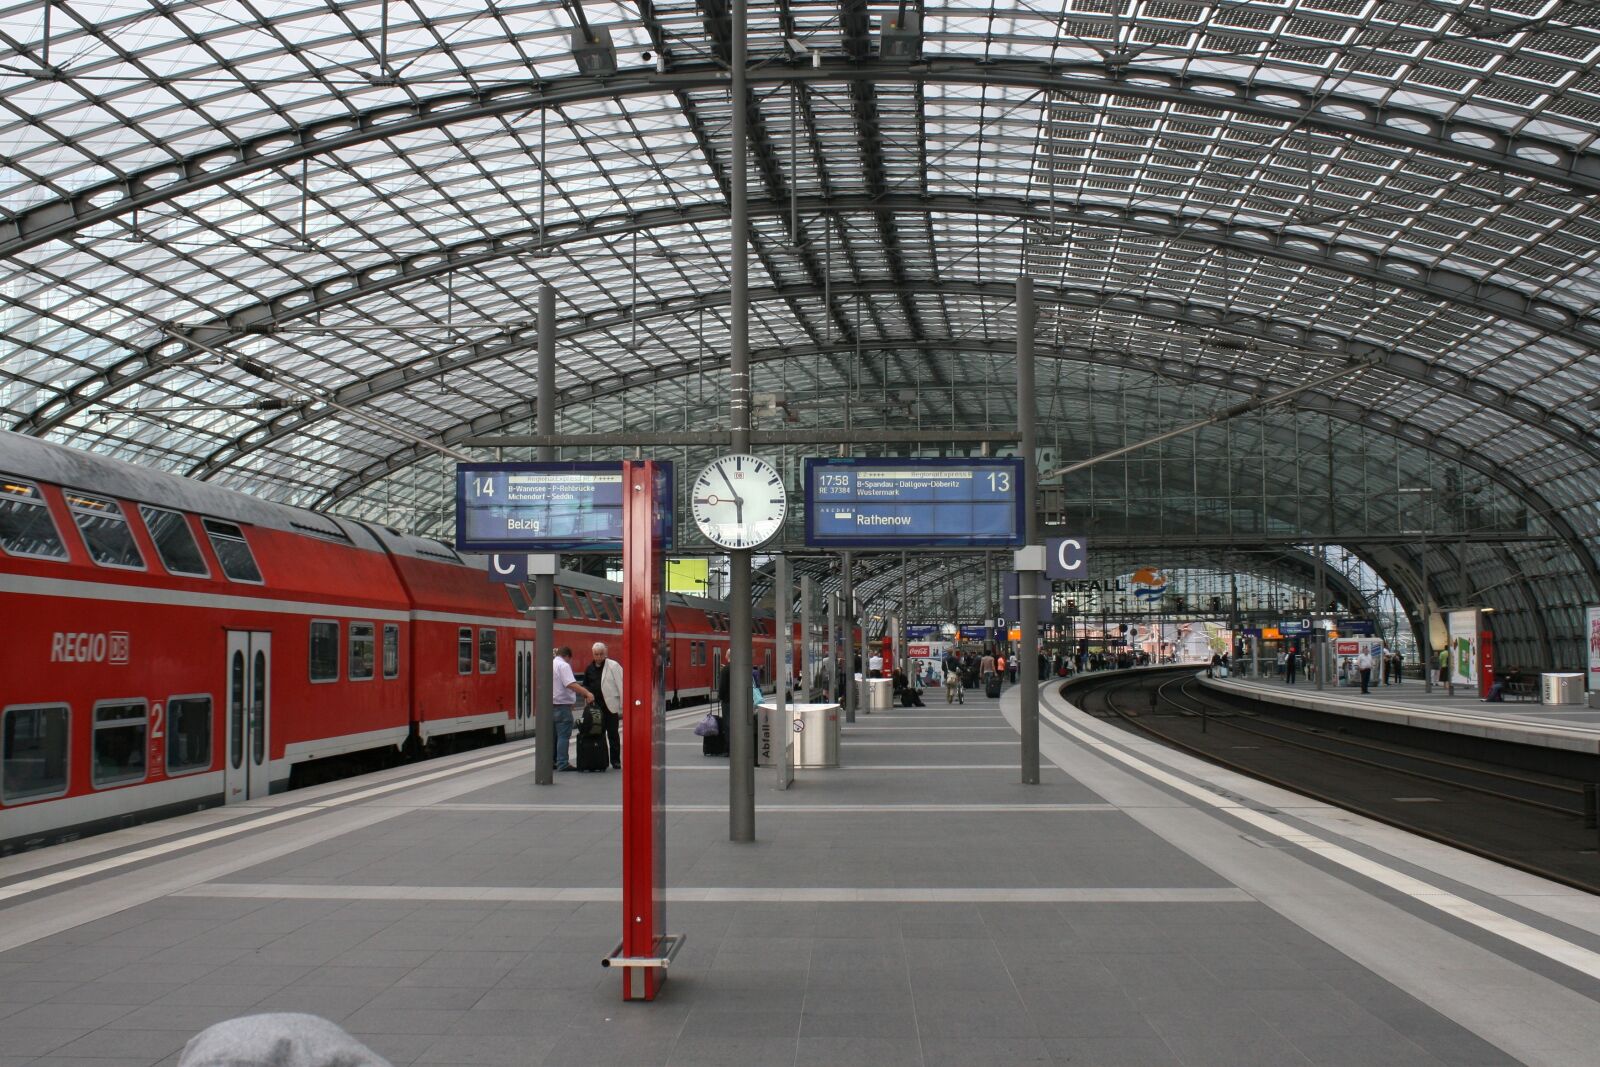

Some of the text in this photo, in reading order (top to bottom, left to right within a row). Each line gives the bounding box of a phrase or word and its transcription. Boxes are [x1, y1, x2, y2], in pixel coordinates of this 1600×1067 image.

[472, 477, 494, 497] 14
[820, 475, 849, 486] 17:58
[986, 472, 1010, 492] 13
[508, 519, 540, 531] Belzig
[857, 514, 911, 525] Rathenow
[493, 554, 516, 575] C
[1058, 539, 1082, 571] C
[1051, 580, 1127, 592] ENFALL
[997, 618, 1005, 628] D
[1302, 619, 1311, 629] D
[51, 632, 107, 662] REGIO
[151, 703, 163, 739] 2
[762, 724, 770, 759] Abfall
